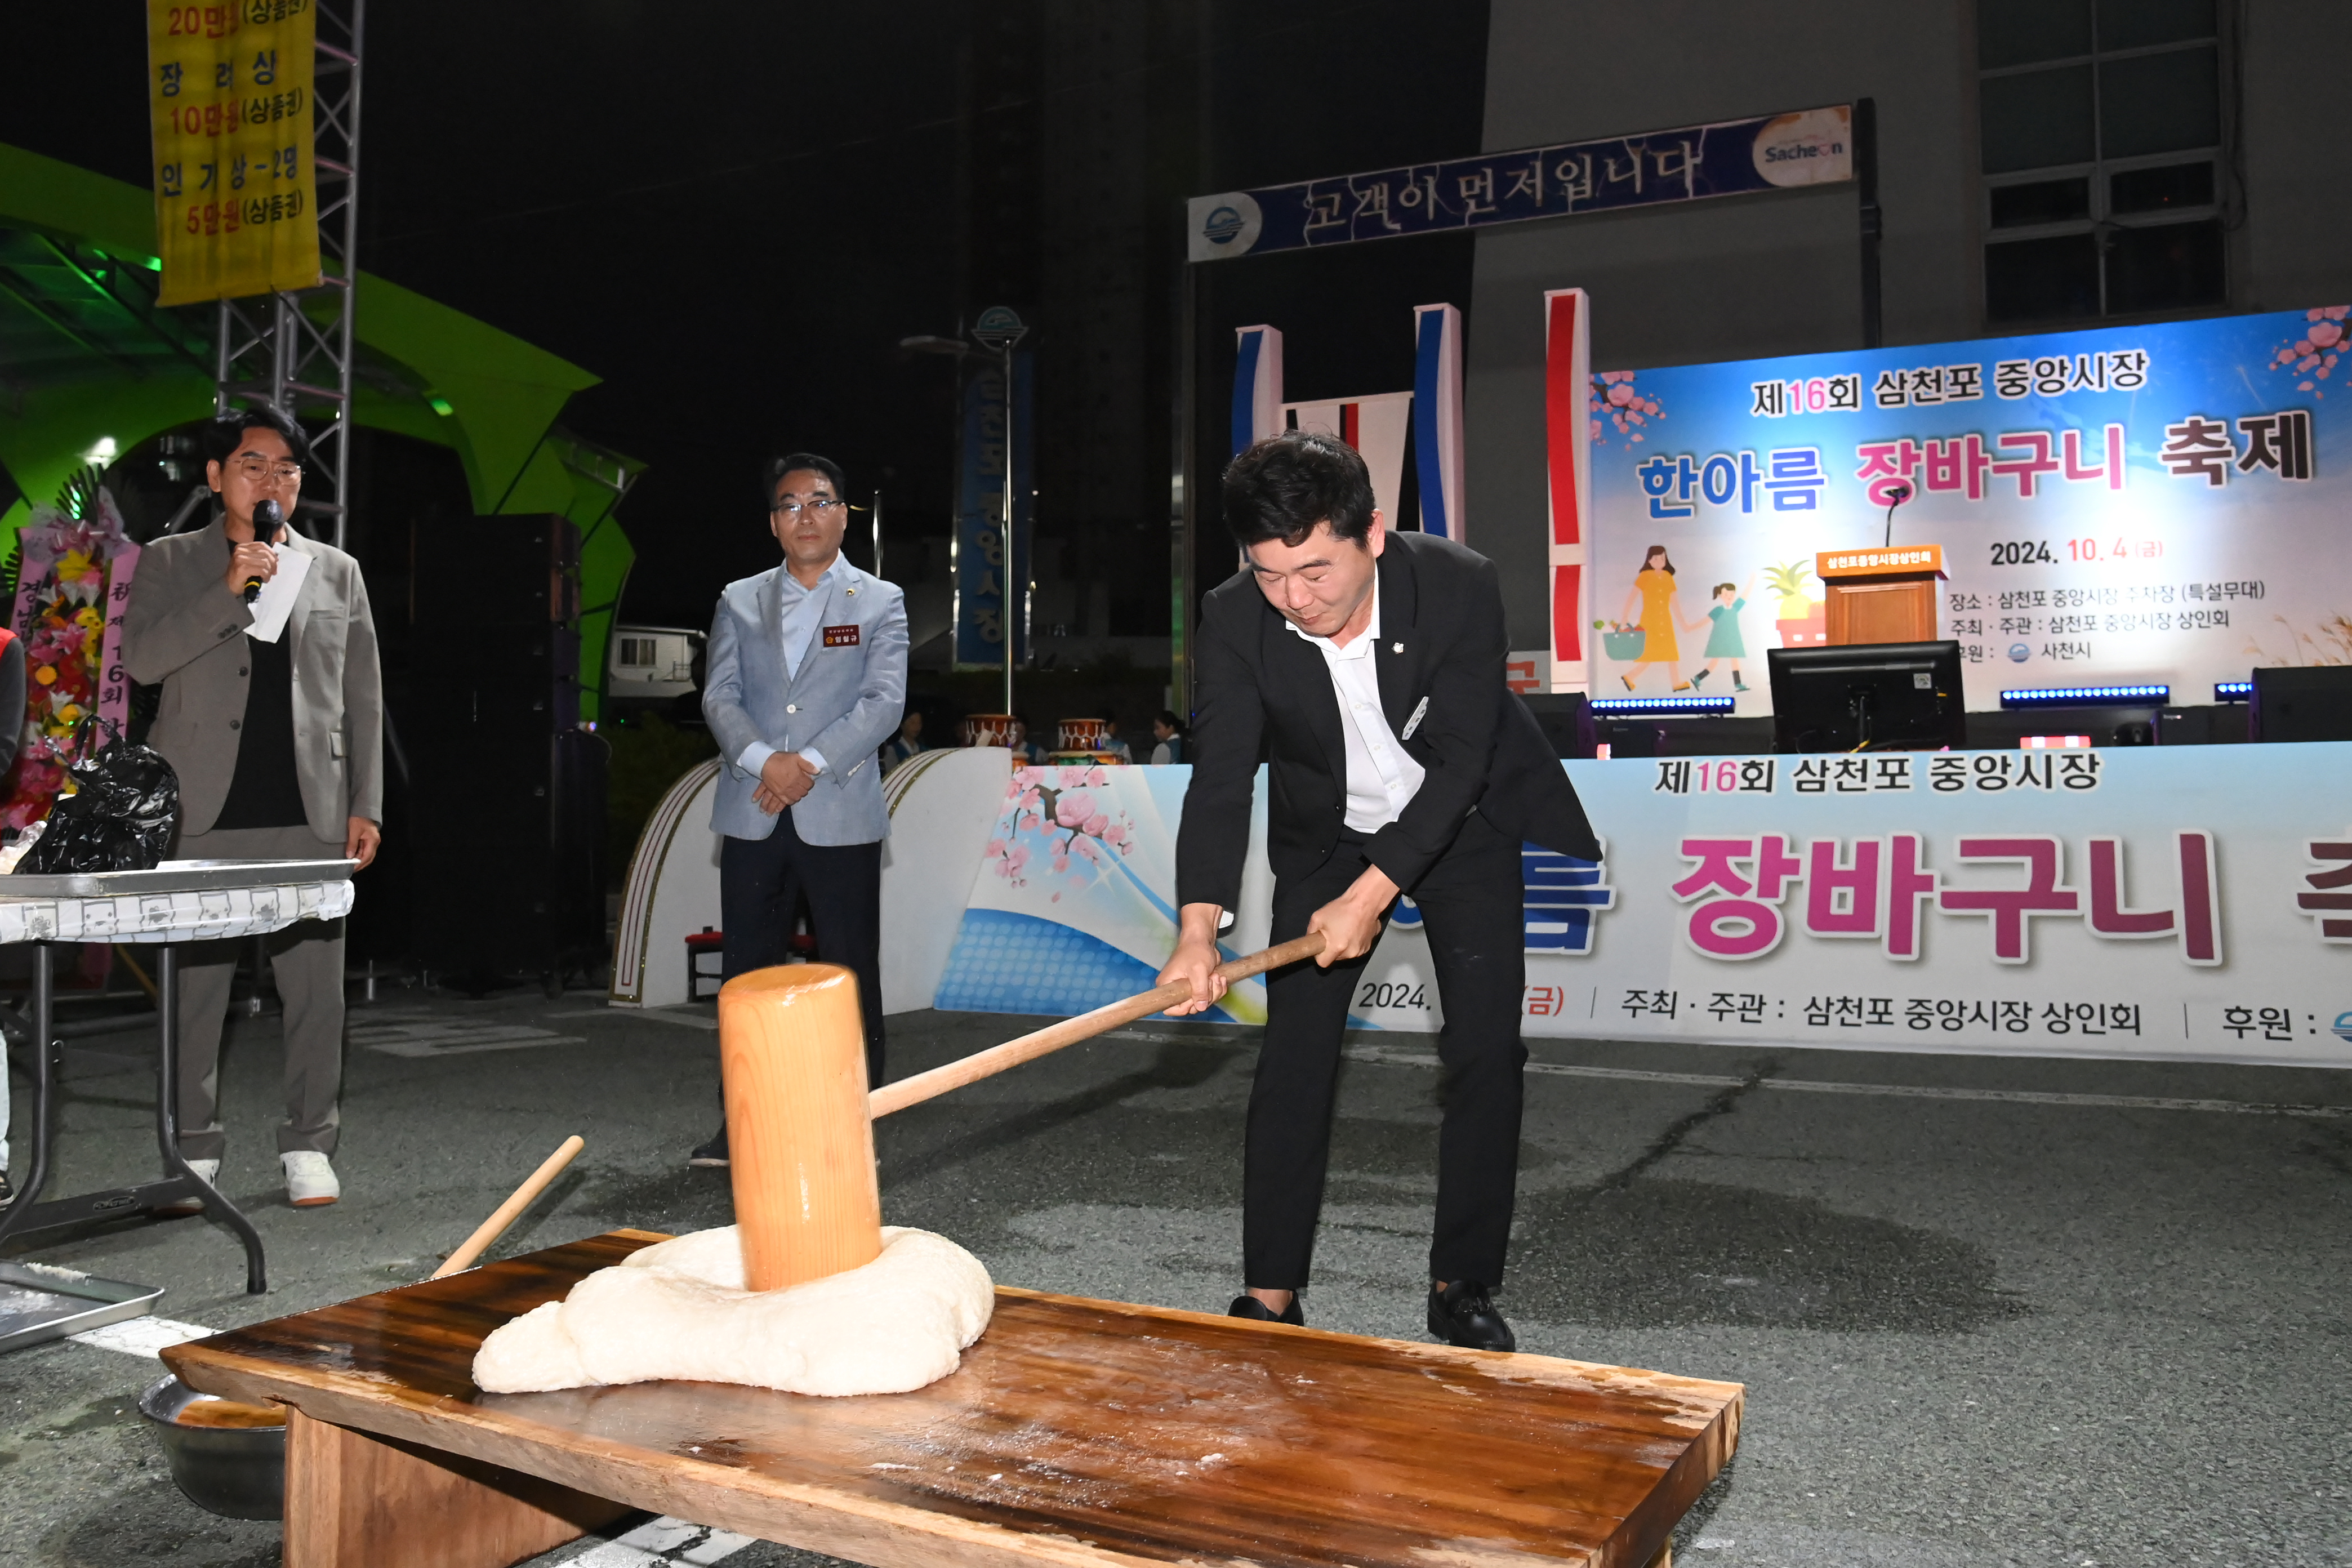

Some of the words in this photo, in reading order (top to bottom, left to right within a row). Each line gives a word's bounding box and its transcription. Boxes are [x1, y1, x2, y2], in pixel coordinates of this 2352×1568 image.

[1307, 175, 1436, 231] 고객이
[1456, 140, 1700, 214] 먼저입니다
[1755, 377, 1857, 413] 제16회
[1876, 368, 1980, 404] 삼천포
[1997, 352, 2147, 397] 중앙시장
[1639, 451, 1824, 518] 한아름
[1859, 427, 2123, 505] 장바구니
[2162, 413, 2309, 486] 축제
[1990, 541, 2058, 565] 2024.
[2068, 538, 2104, 562] 10.
[2135, 540, 2163, 558] (금)
[1949, 593, 1982, 611] 장소
[1998, 590, 2047, 609] 삼천포
[2052, 588, 2118, 608] 중앙시장
[2126, 585, 2175, 604] 주차장
[2181, 580, 2265, 602] (특설무대)
[1951, 619, 1983, 637] 주최
[1999, 617, 2033, 635] 주관
[2048, 615, 2098, 634] 삼천포
[2105, 612, 2172, 632] 중앙시장
[2177, 609, 2229, 630] 상인회
[2041, 641, 2091, 661] 사천시
[1655, 760, 1774, 793] 제16회
[1793, 756, 1910, 792] 삼천포
[1931, 754, 2100, 791] 중앙시장
[1673, 833, 2215, 960] 장바구니
[1359, 983, 1431, 1011] 2024.
[1522, 985, 1564, 1017] 금)
[1622, 990, 1677, 1019] 주최
[1708, 993, 1767, 1023] 주관
[1804, 996, 1894, 1027] 삼천포
[1905, 999, 2033, 1033] 중앙시장
[2042, 1003, 2140, 1036] 상인회
[2223, 1006, 2292, 1041] 후원
